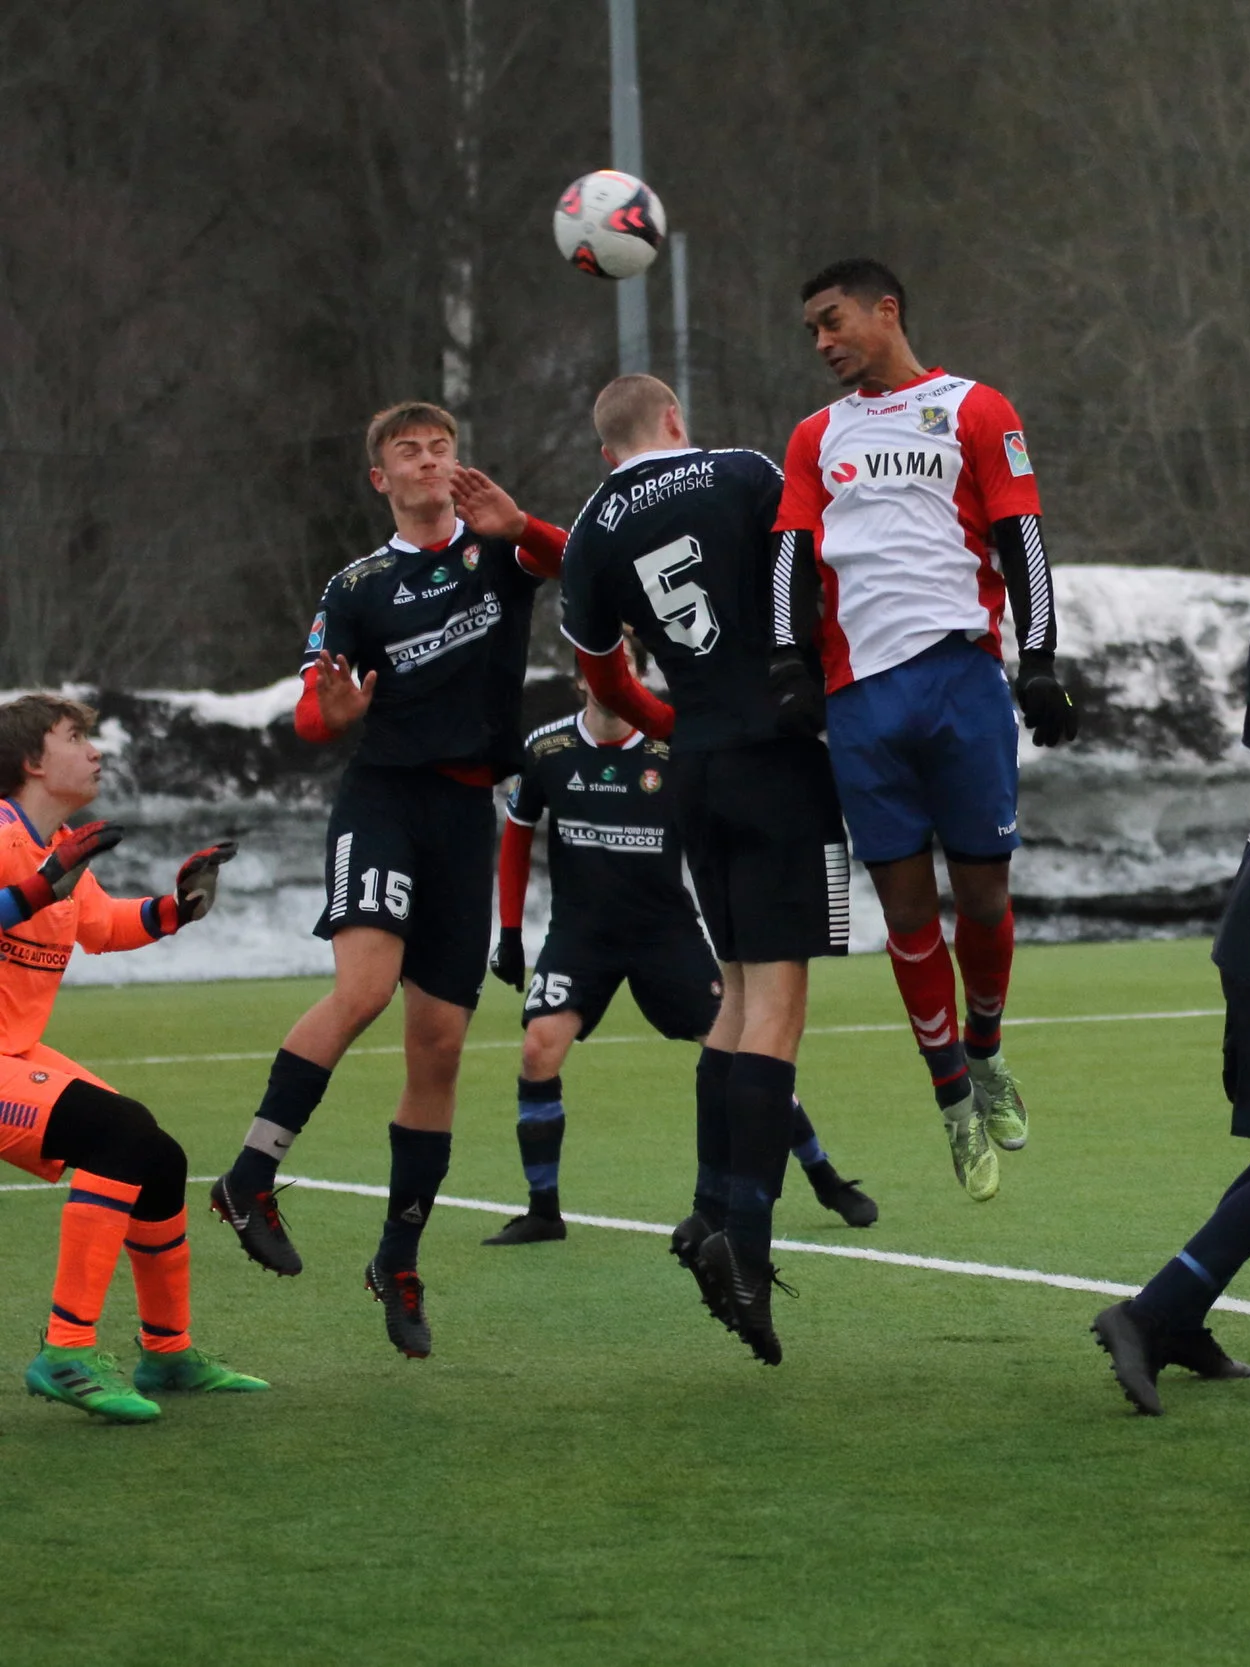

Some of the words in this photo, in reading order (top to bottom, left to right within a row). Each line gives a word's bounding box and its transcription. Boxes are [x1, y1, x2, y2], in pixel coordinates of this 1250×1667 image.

[867, 401, 907, 416] hummel
[865, 452, 943, 479] VISMA
[631, 461, 714, 502] DRØBAK
[631, 473, 714, 514] ELEKTRISKE
[633, 534, 720, 656] 5
[388, 640, 441, 667] FOLLO
[589, 782, 627, 793] stamina
[558, 827, 596, 840] FOLLO
[600, 833, 656, 847] AUTOCO
[358, 867, 413, 920] 15
[0, 941, 30, 959] OLLO
[525, 972, 572, 1011] 25
